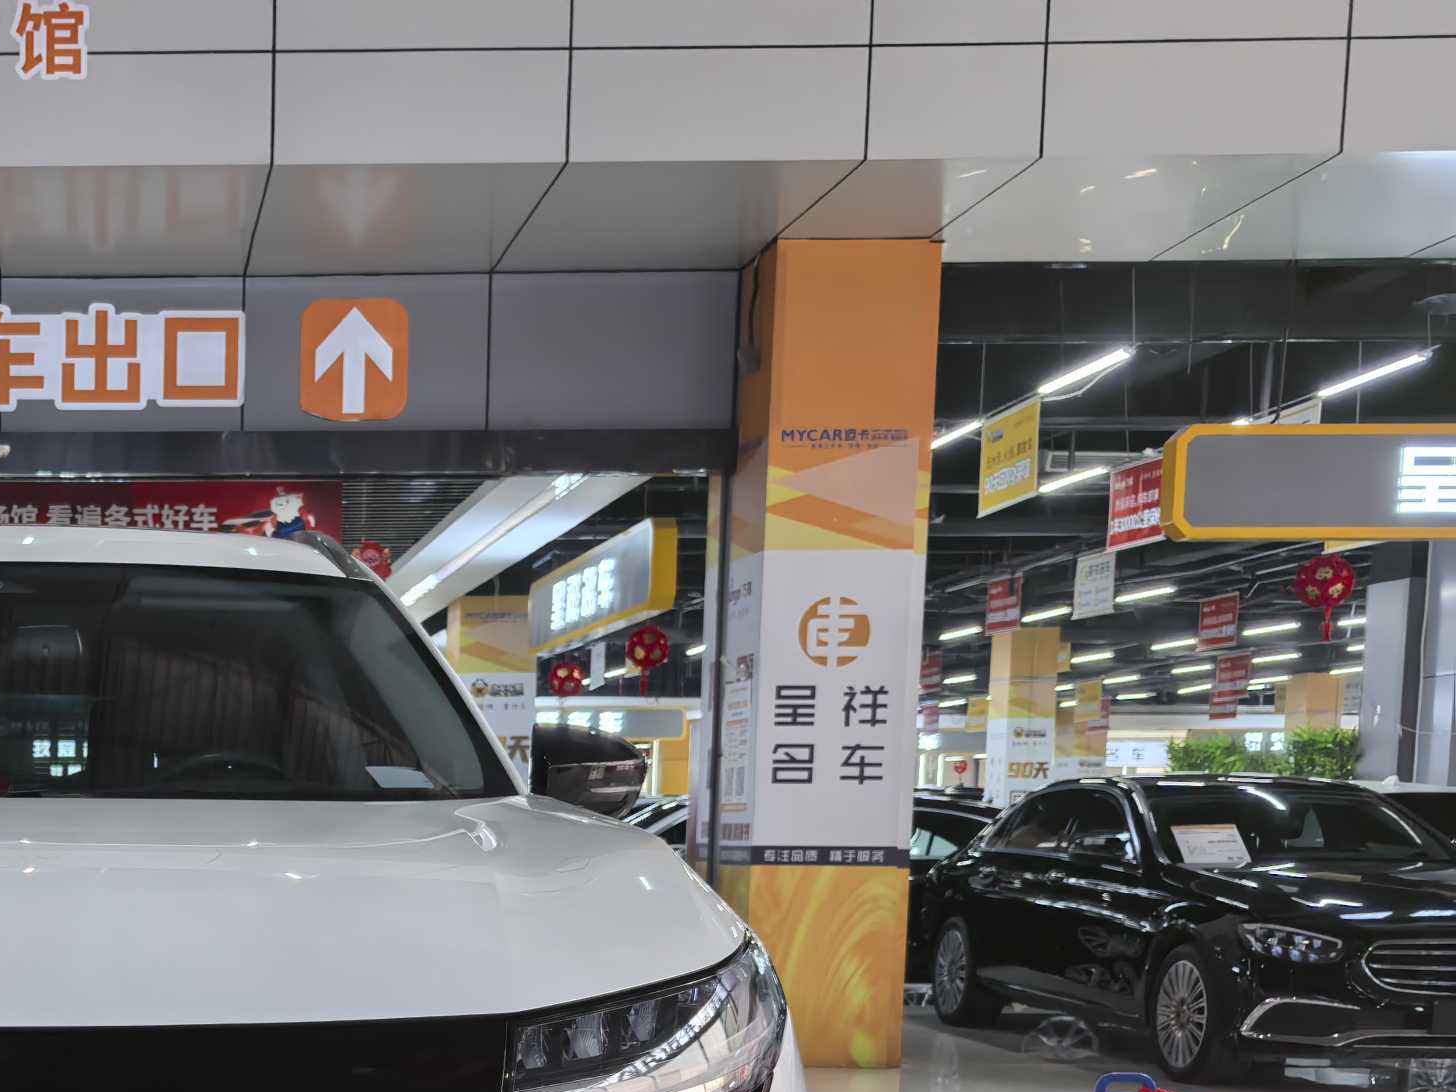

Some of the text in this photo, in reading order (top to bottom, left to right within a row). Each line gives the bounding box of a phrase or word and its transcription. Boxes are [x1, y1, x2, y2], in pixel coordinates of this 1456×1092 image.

[774, 685, 889, 728] 呈祥
[771, 743, 885, 786] 名车
[1008, 761, 1049, 779] 90天
[763, 849, 885, 864] 专注品质 精于服务
